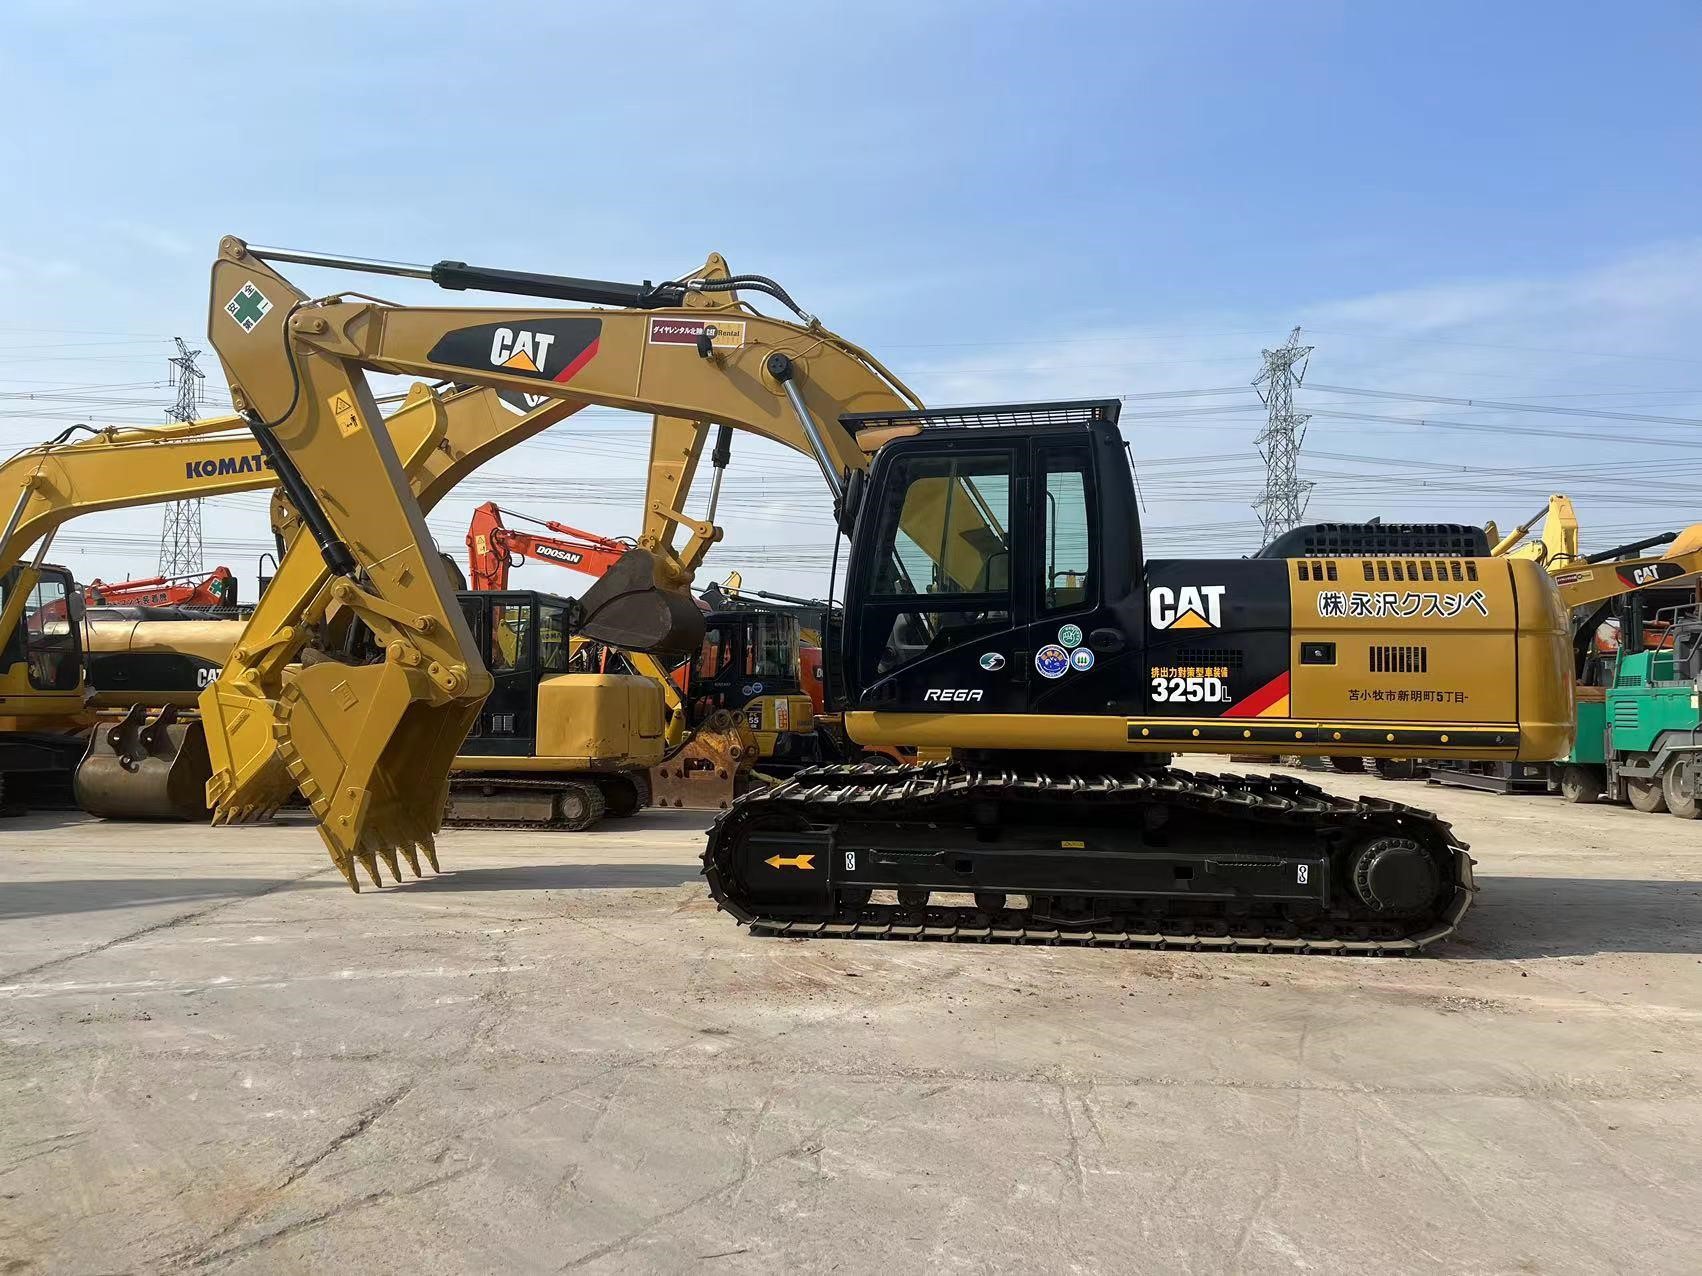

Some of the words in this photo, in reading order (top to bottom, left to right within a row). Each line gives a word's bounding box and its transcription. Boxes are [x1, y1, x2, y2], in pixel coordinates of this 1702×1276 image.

[490, 327, 555, 373] CAT
[536, 545, 580, 563] DOOSAN
[1633, 564, 1659, 585] CAT
[1149, 585, 1226, 630] CAT
[923, 689, 984, 702] REGA
